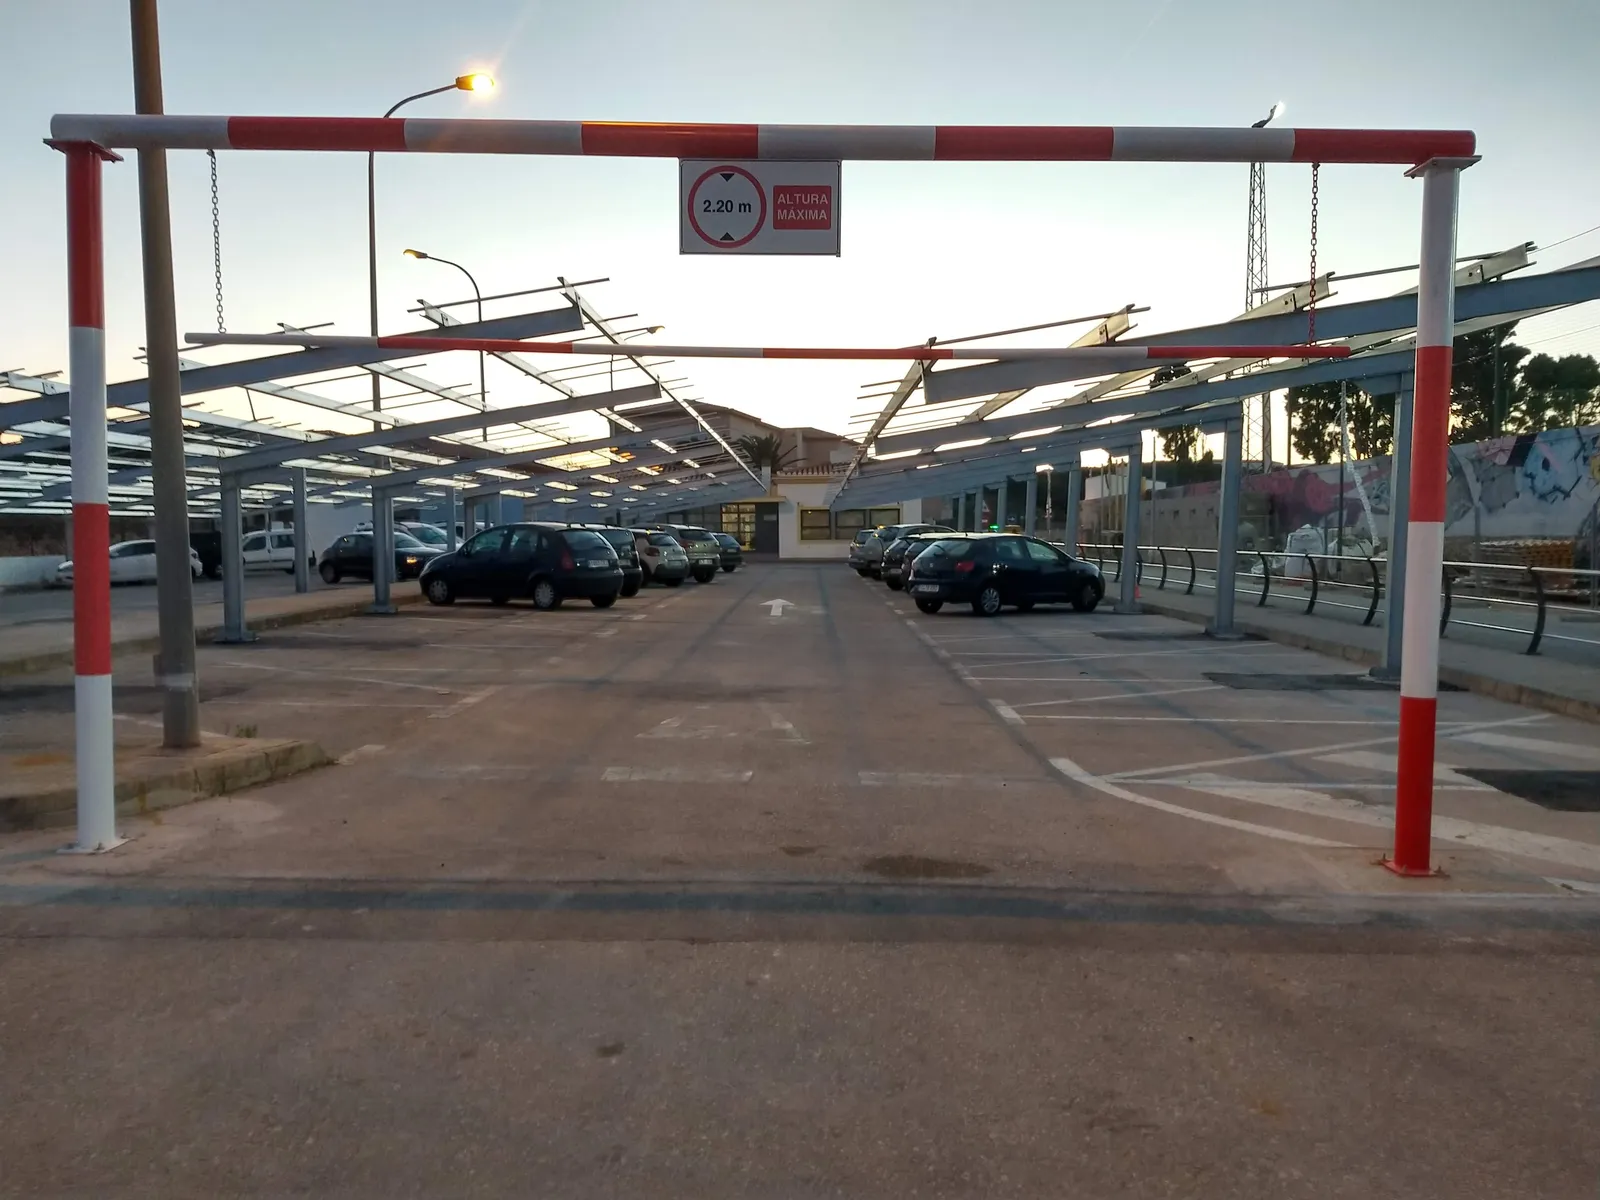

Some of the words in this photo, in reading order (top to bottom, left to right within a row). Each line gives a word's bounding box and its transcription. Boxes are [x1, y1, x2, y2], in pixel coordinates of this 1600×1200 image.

[777, 193, 829, 205] ALTURA
[703, 200, 733, 213] 2.20
[738, 202, 752, 213] m
[777, 207, 828, 220] MÁXIMA
